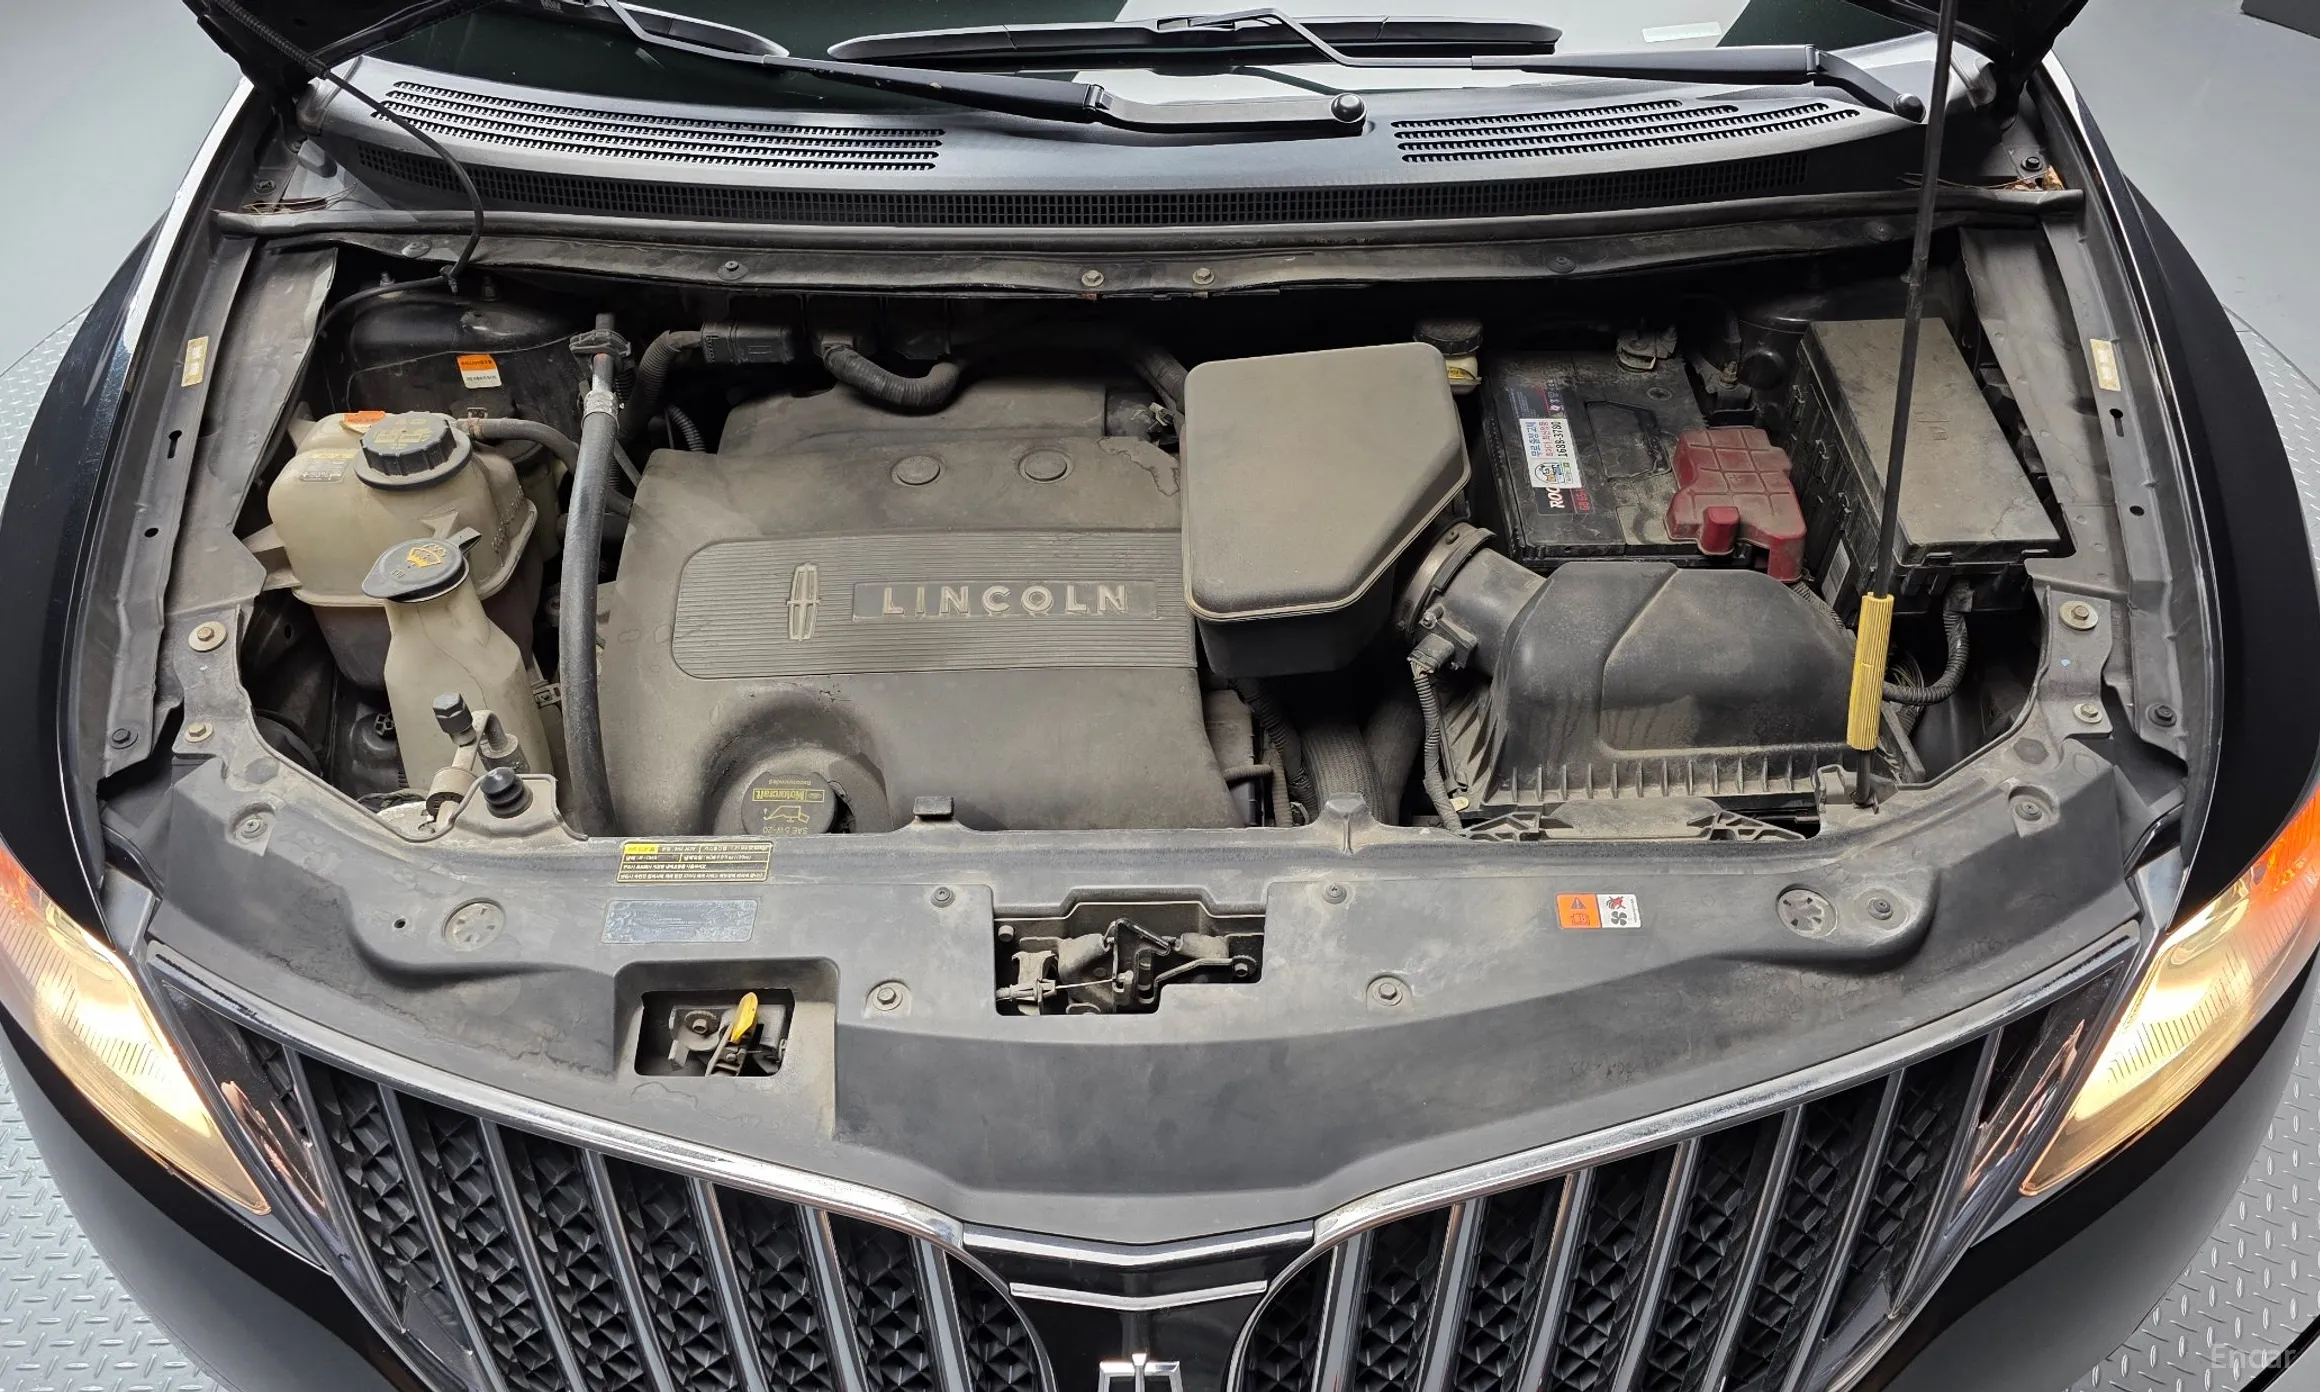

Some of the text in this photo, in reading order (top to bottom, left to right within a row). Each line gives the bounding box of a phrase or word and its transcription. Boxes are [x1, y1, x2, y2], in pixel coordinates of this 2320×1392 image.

[882, 585, 1129, 615] LINCOLN
[755, 790, 805, 801] Motorcraft
[762, 826, 809, 835] SAE 5W-20
